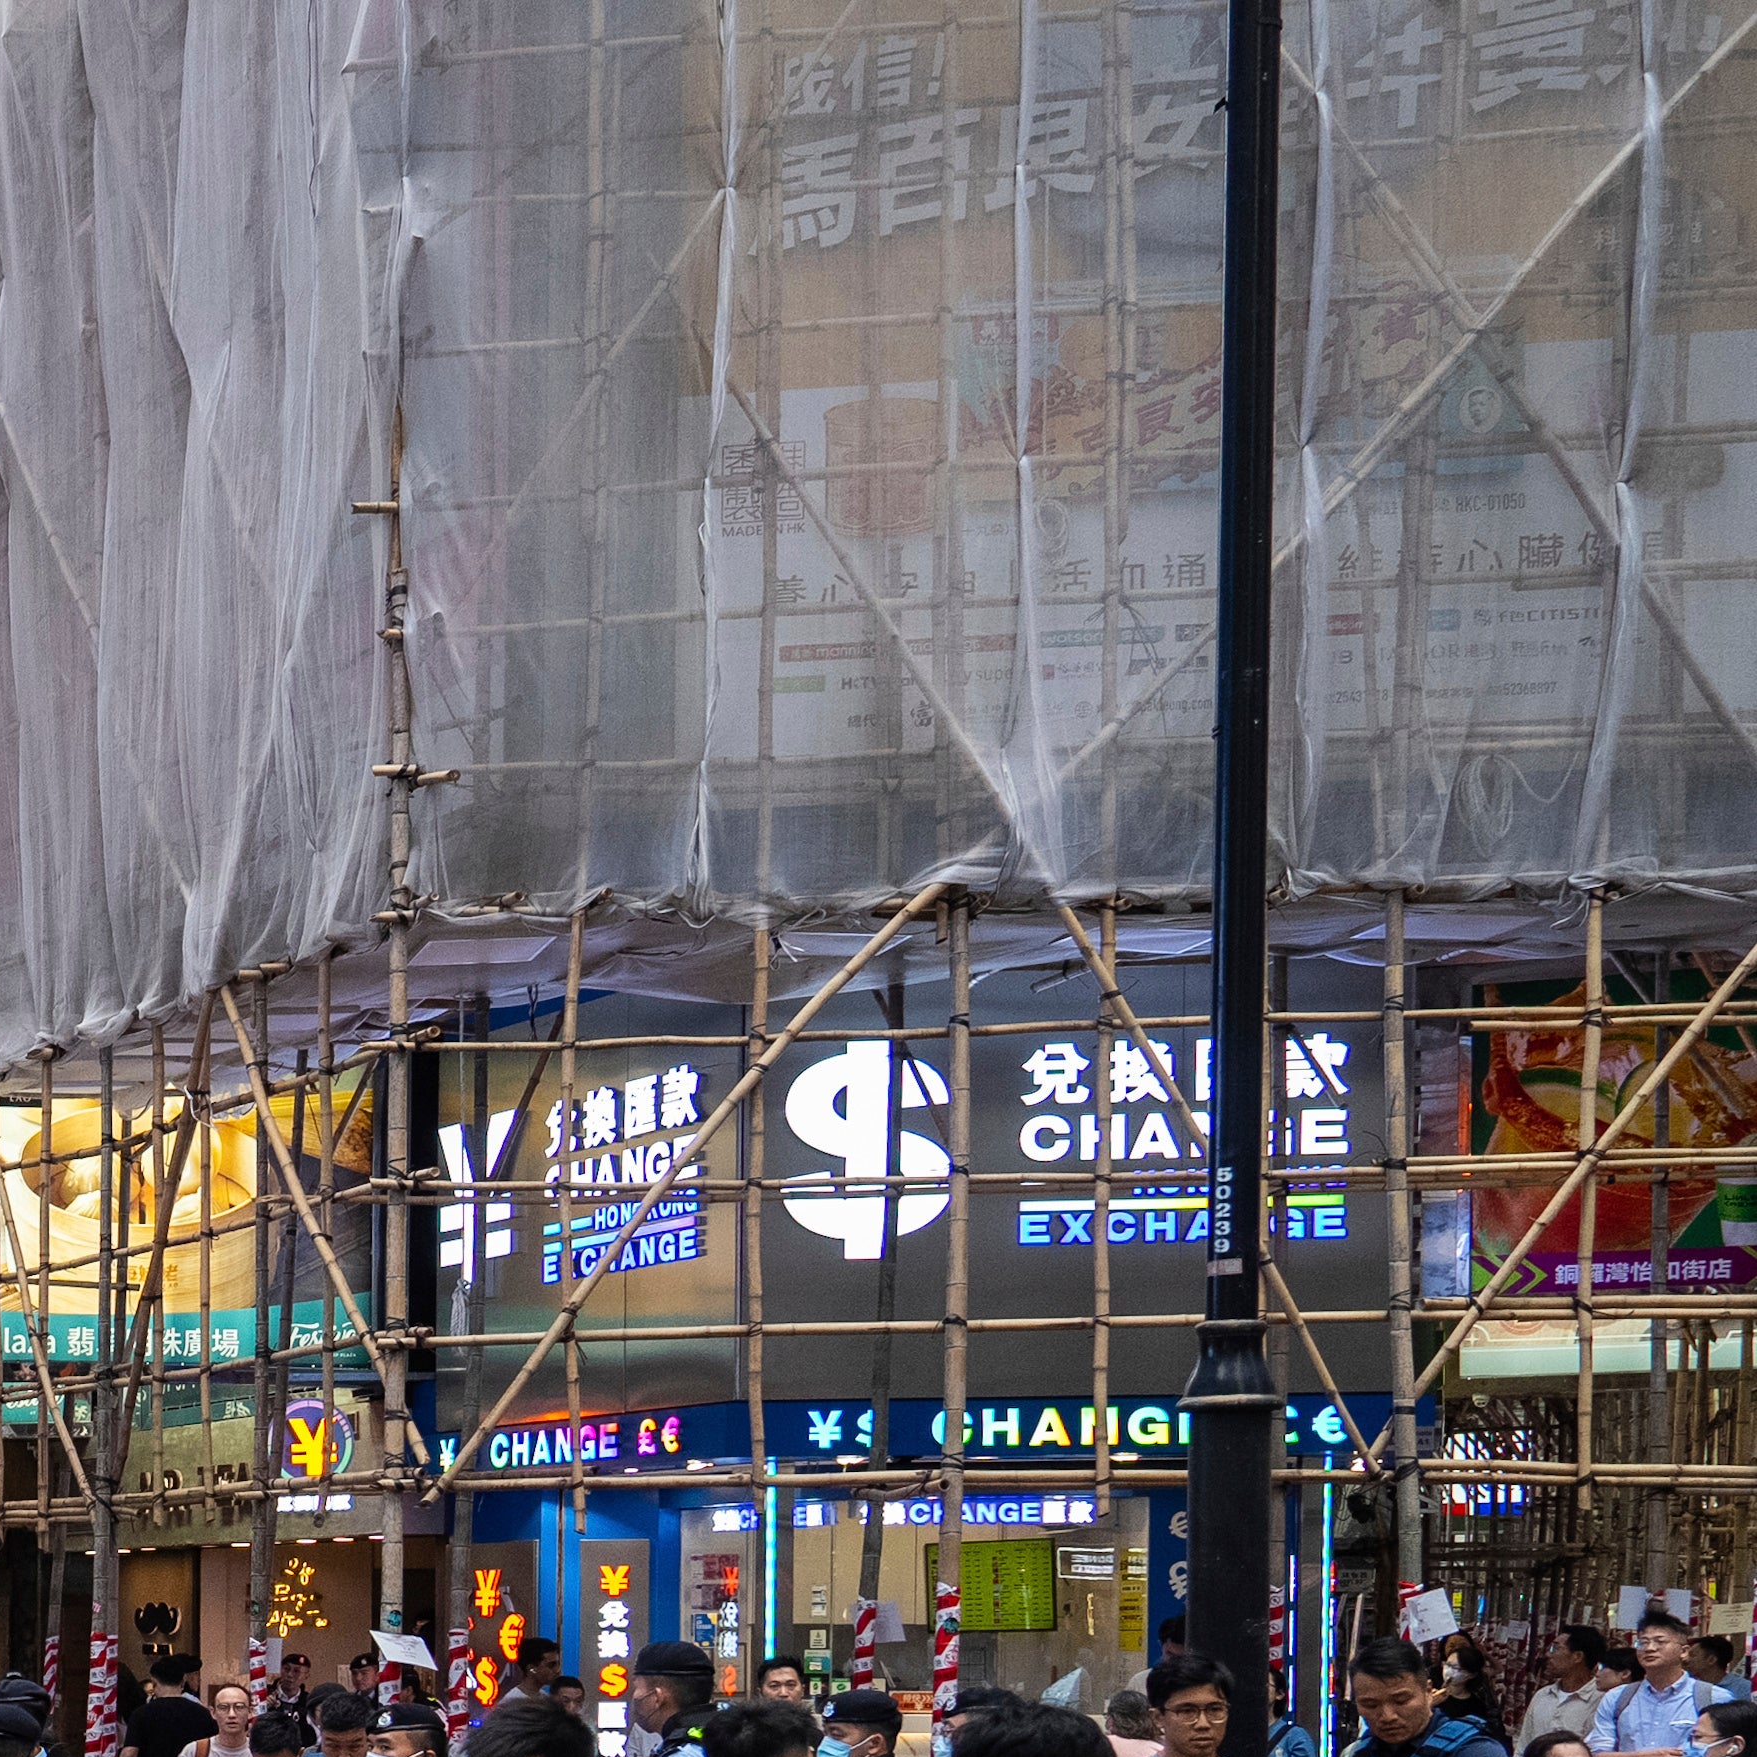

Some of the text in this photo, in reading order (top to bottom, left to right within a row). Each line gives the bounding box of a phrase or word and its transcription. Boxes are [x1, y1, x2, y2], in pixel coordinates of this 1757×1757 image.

[782, 1039, 951, 1260] $
[1216, 1164, 1233, 1254] 50239
[489, 1421, 619, 1469] CHANGE
